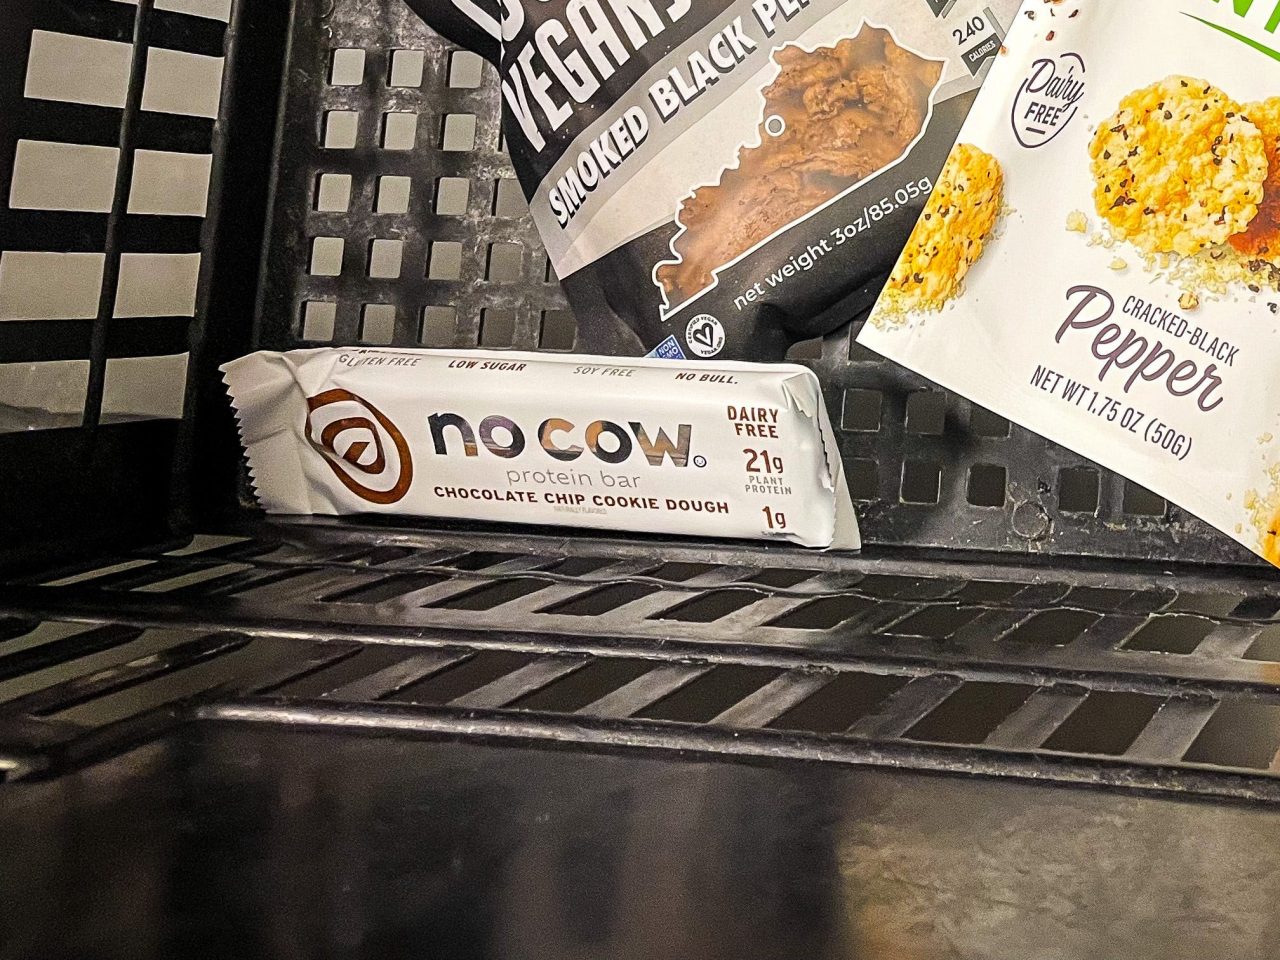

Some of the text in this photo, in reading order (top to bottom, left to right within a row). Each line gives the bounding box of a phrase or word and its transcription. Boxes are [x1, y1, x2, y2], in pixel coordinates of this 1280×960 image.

[952, 15, 985, 46] 240
[968, 40, 997, 62] CALORIES
[1025, 58, 1085, 113] Dairy
[549, 104, 649, 230] SMOKED
[655, 15, 758, 120] BLACK
[1023, 101, 1063, 127] FREE
[733, 176, 934, 312] net weight 3oz/85.05g
[1122, 295, 1240, 367] CRACKED-BLACK
[658, 339, 675, 355] NON
[1055, 284, 1224, 412] Pepper
[388, 356, 422, 368] FREE
[448, 359, 527, 372] LOW SUGAR
[573, 366, 636, 378] SOY FREE
[675, 372, 739, 385] NO BULL.
[727, 405, 779, 424] DAIRY
[1030, 364, 1193, 461] NET WT 1.75 OZ (50G)
[427, 412, 526, 459] no
[734, 423, 779, 439] FREE
[742, 448, 784, 474] 21g
[506, 468, 641, 488] protein bar
[745, 484, 792, 495] PROTEIN
[748, 475, 784, 486] PLANT
[434, 486, 730, 514] CHOCOLATE CHIP COOKIE DOUGH
[762, 505, 787, 529] 1g
